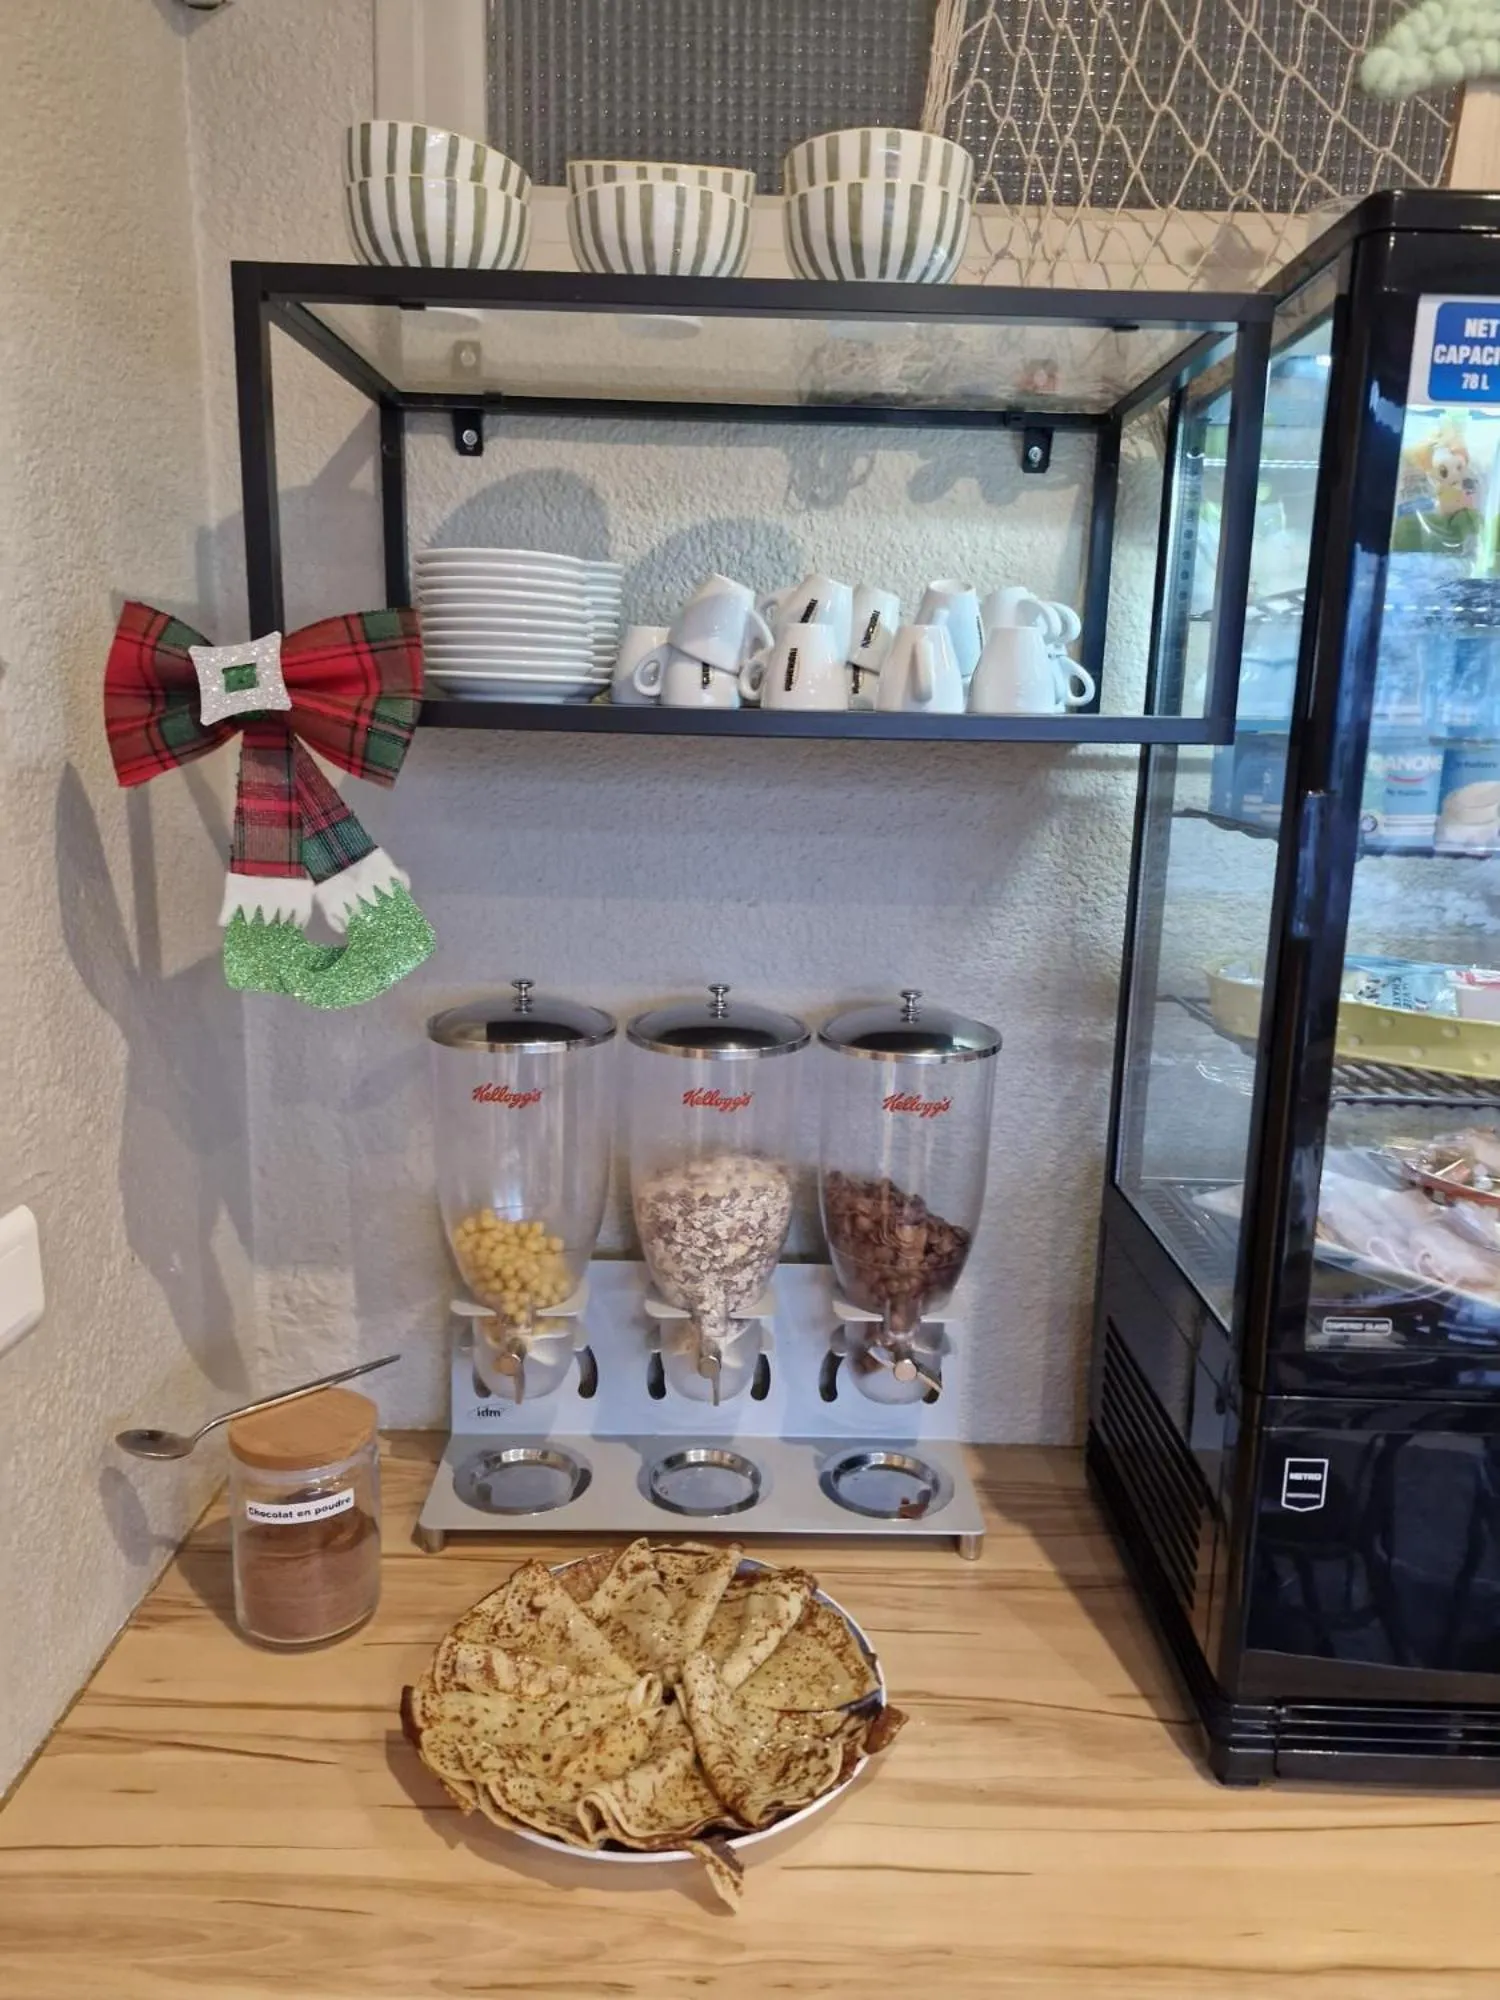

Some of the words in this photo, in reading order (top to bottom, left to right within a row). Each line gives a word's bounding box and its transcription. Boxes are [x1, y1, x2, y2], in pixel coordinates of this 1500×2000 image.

[1463, 317, 1500, 338] NET
[1480, 373, 1490, 390] L
[472, 1083, 542, 1109] Kellogg's
[682, 1088, 753, 1112] Kellogg's
[882, 1093, 952, 1118] Kellogg's
[477, 1406, 501, 1417] idm
[1289, 1472, 1322, 1481] METRO
[248, 1507, 293, 1519] Chocolat
[296, 1510, 311, 1518] en
[314, 1497, 352, 1515] poudre
